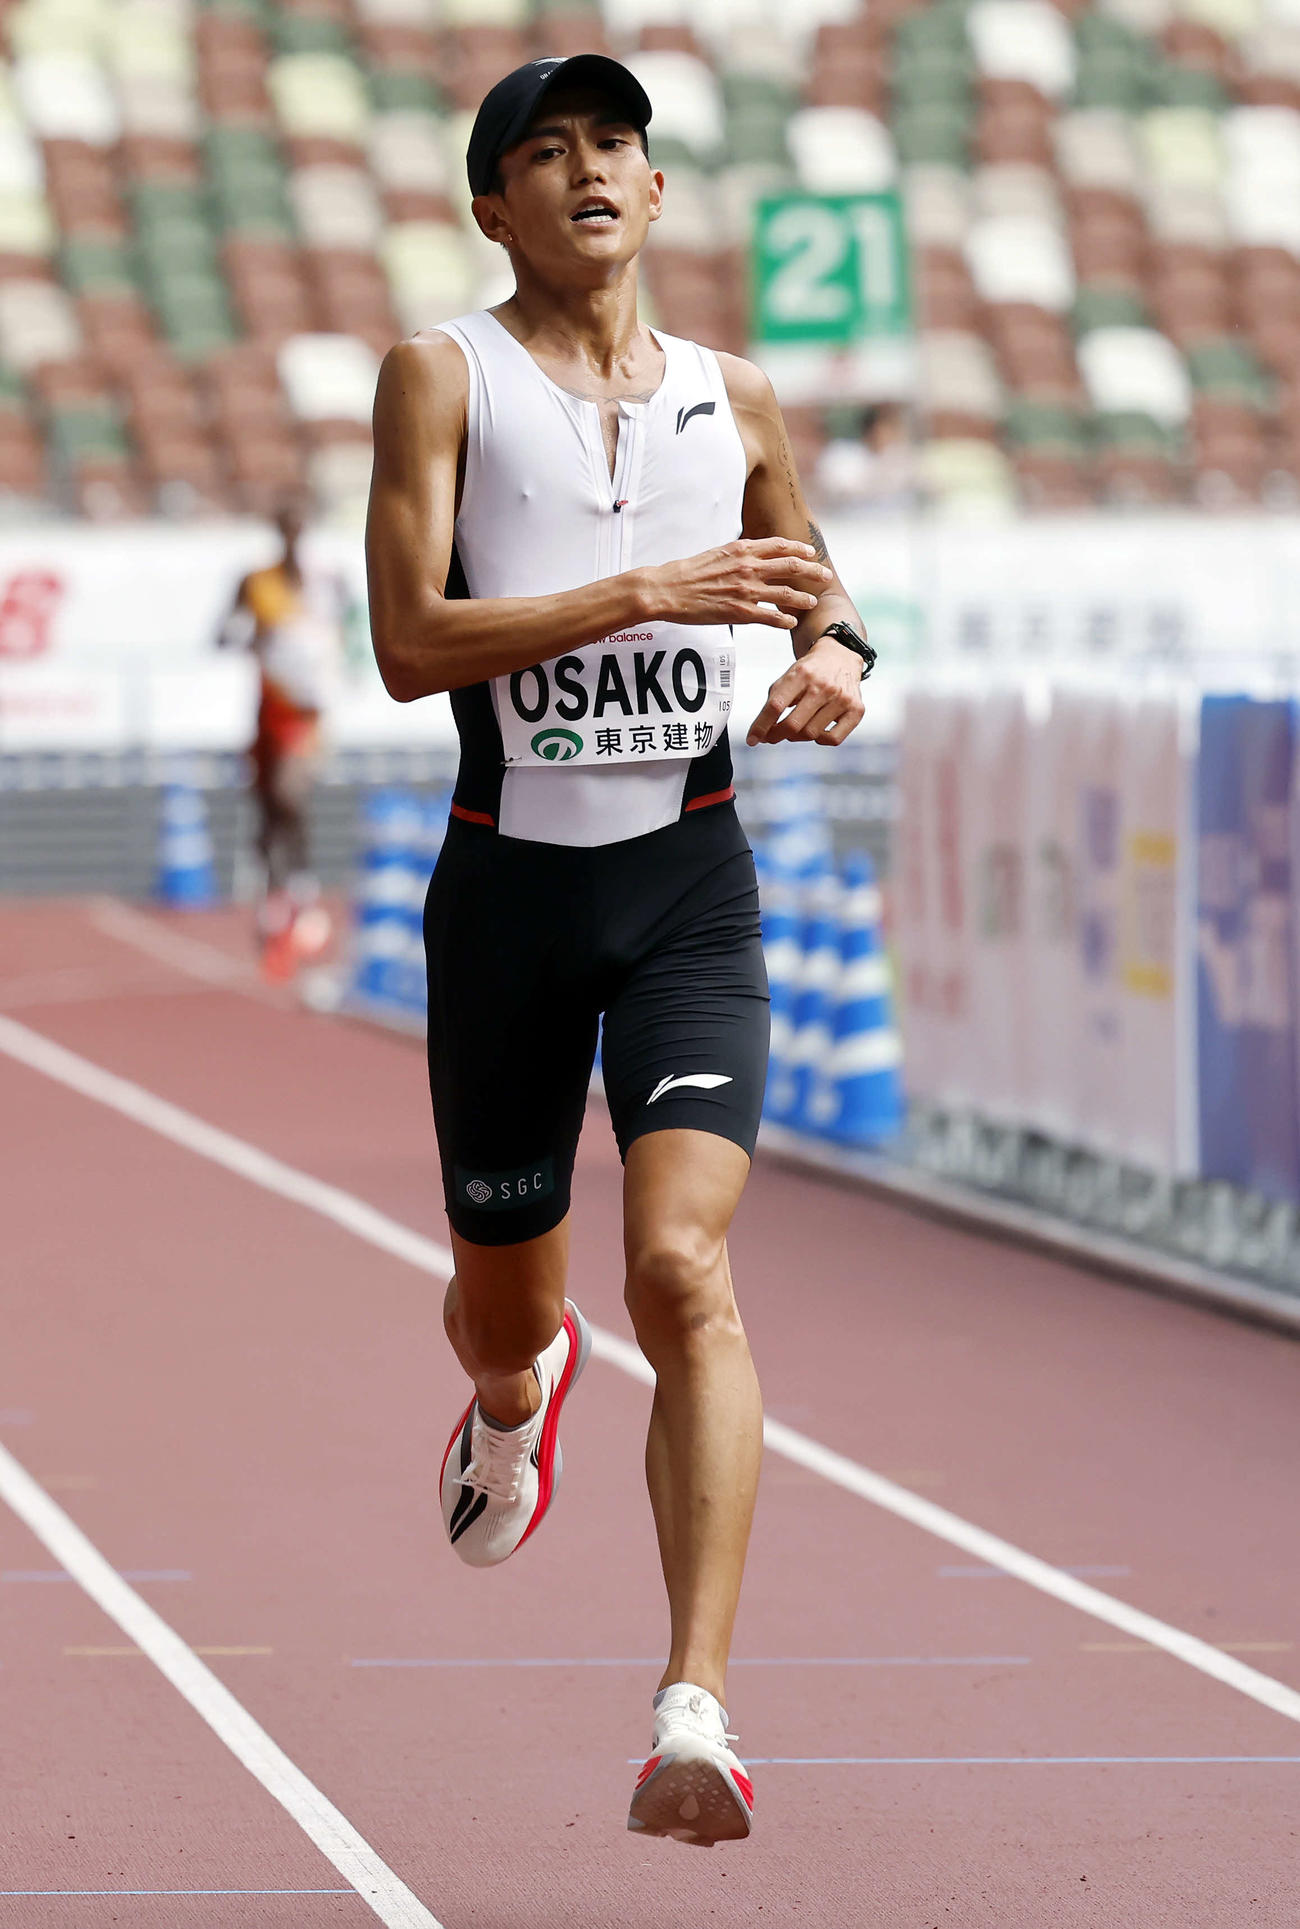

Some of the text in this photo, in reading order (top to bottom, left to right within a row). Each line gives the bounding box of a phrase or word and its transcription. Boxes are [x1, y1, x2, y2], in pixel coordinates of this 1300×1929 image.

[767, 205, 898, 322] 21
[609, 632, 654, 643] balance
[510, 648, 706, 723] OSAKO
[719, 700, 731, 712] 105
[594, 721, 714, 756] 東京建物
[500, 1173, 542, 1199] SGC
